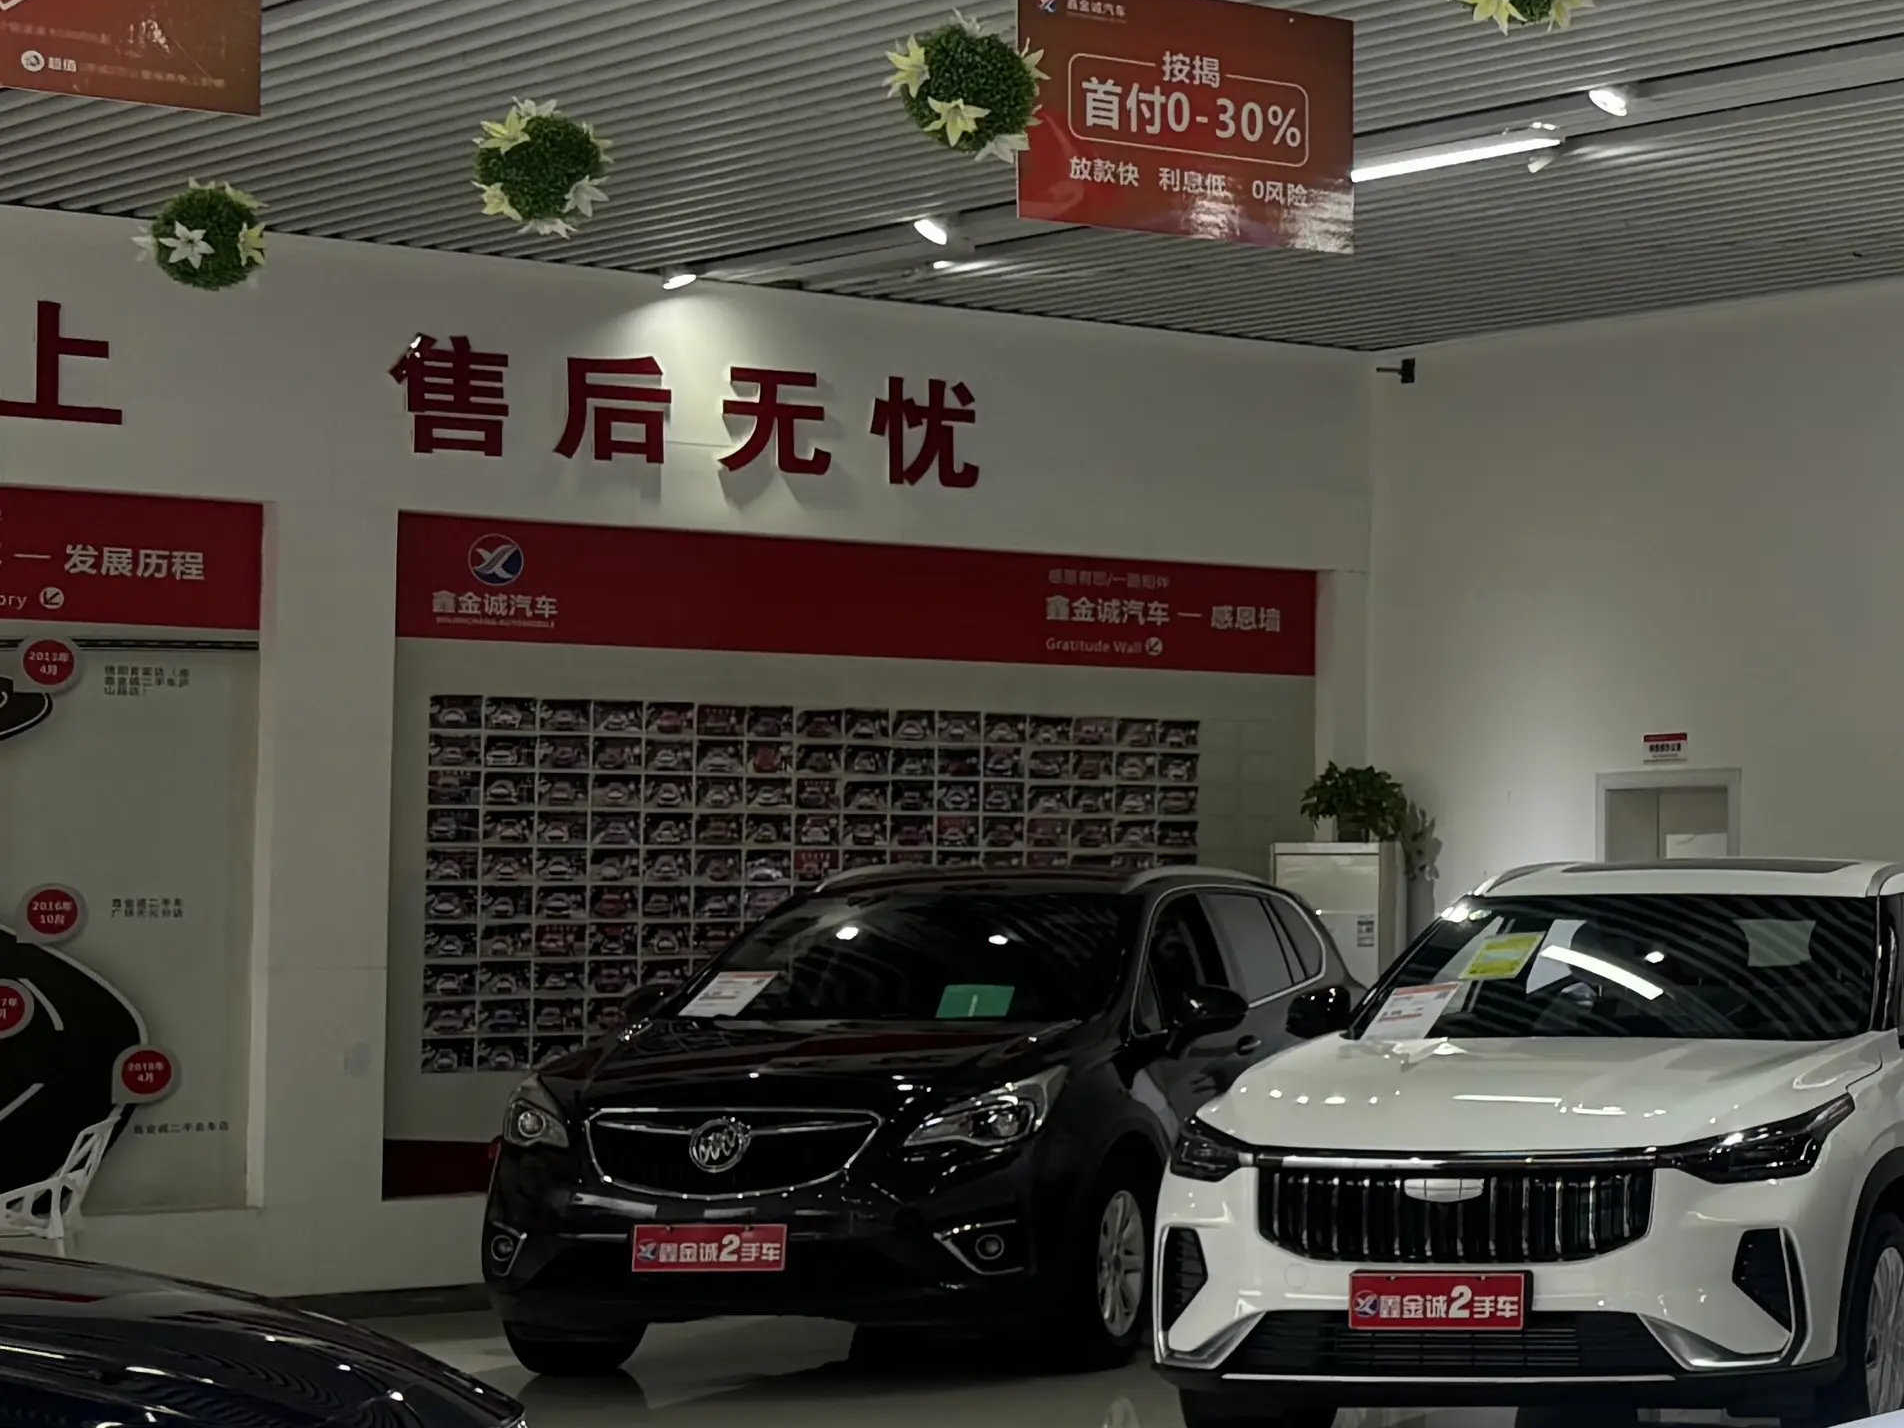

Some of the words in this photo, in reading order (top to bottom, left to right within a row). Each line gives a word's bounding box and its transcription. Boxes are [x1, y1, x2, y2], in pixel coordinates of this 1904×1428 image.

[1161, 51, 1221, 88] 按揭
[1081, 77, 1301, 149] 首付0-30%
[1069, 155, 1140, 188] 放款快
[1158, 166, 1229, 196] 利息低
[1252, 179, 1309, 207] 0风险
[0, 299, 123, 425] 上
[387, 333, 981, 490] 售后无忧
[64, 543, 206, 582] 发展历程
[432, 589, 559, 619] 鑫金诚汽车
[1045, 594, 1171, 627] 鑫金诚汽车
[1210, 605, 1282, 633] 感恩墙
[1045, 636, 1110, 652] Gratitude
[1112, 638, 1143, 653] Wall
[137, 1072, 155, 1084] 4月
[659, 1233, 781, 1263] 鑫金诚2手车
[1379, 1285, 1519, 1319] 鑫金诚2手车
